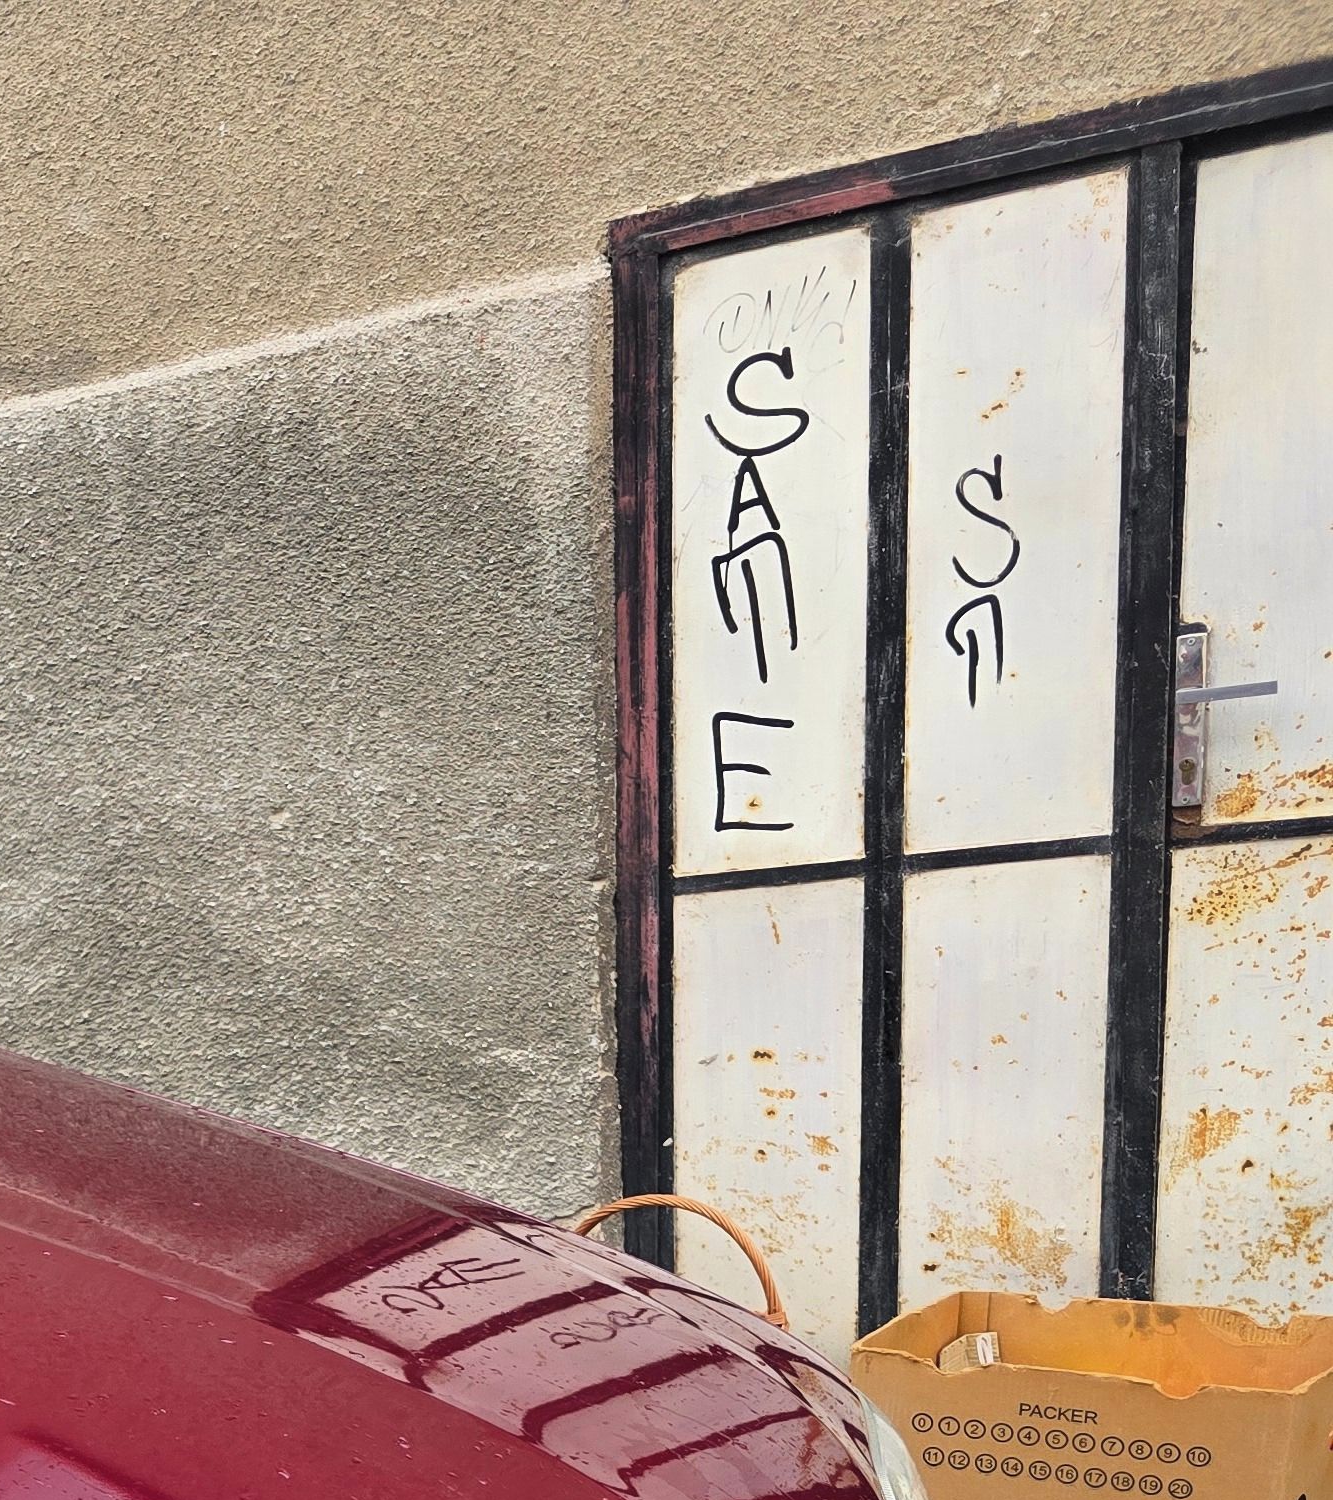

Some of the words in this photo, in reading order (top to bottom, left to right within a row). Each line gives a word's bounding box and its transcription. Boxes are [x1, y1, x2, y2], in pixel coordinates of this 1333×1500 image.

[1018, 1402, 1099, 1425] PACKER
[1189, 1450, 1207, 1464] 10
[925, 1450, 940, 1463] 11
[950, 1454, 967, 1467] 12
[977, 1457, 994, 1470] 13
[1004, 1460, 1020, 1473] 14
[1031, 1464, 1048, 1477] 15
[1058, 1467, 1075, 1481] 16
[1086, 1471, 1103, 1484] 17
[1113, 1475, 1131, 1489] 18
[1141, 1479, 1159, 1491] 19
[1171, 1482, 1190, 1495] 20
